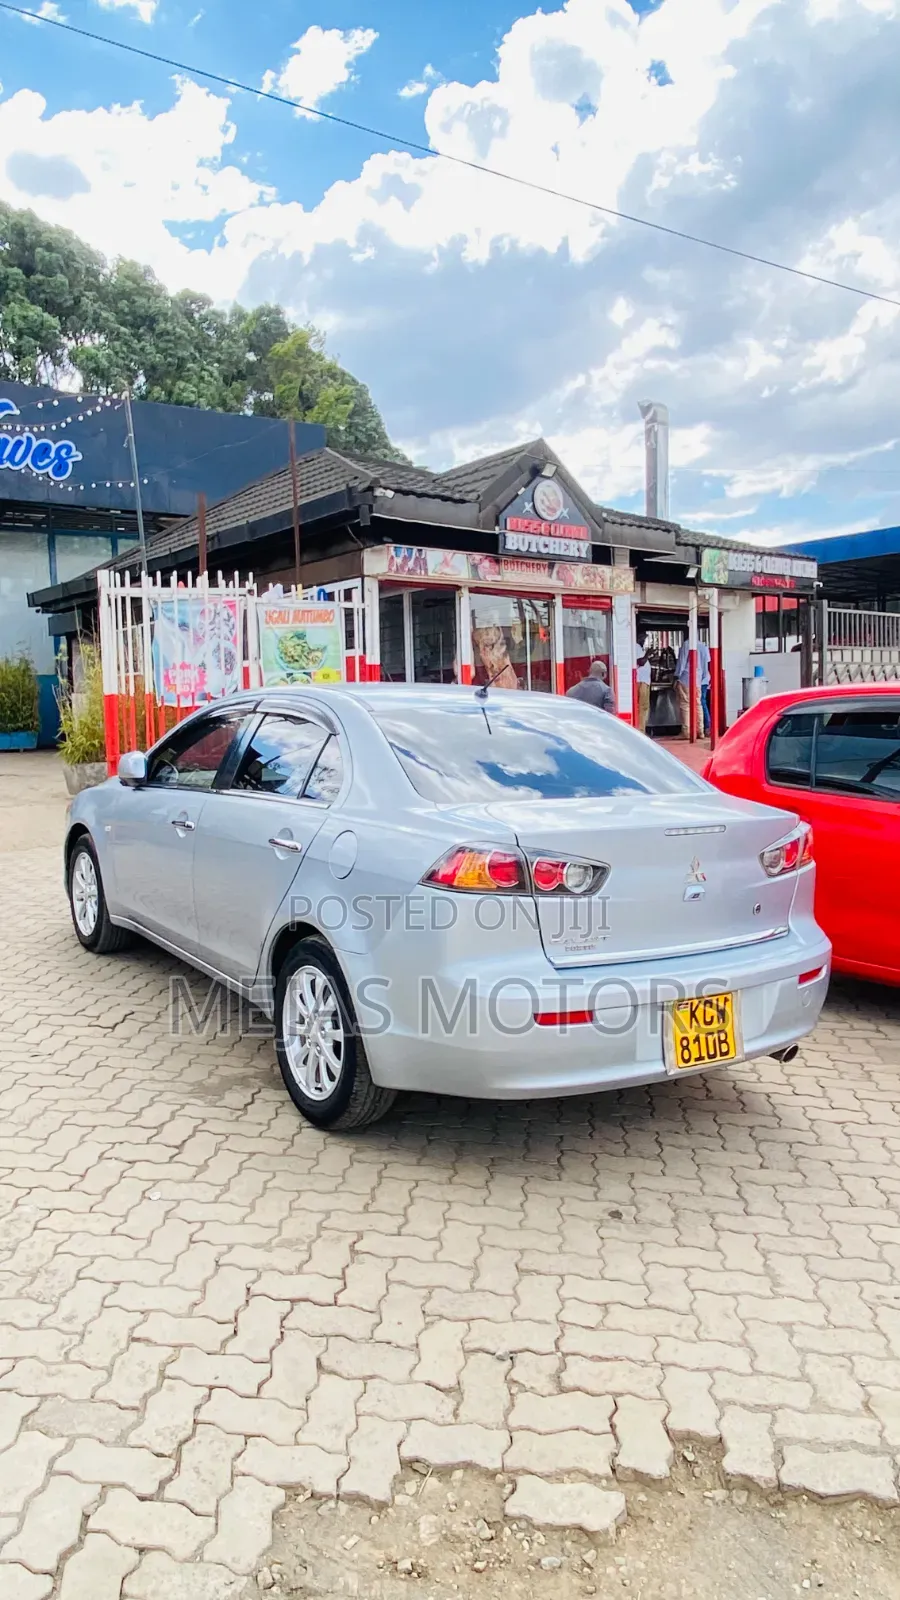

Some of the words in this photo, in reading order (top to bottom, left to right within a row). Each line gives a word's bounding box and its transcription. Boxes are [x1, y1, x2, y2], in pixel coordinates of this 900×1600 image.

[505, 532, 590, 558] BUTCHERY
[503, 559, 547, 574] BUTCHERY
[264, 608, 290, 625] UGALI
[689, 997, 730, 1029] KCW
[680, 1029, 730, 1064] 810B
